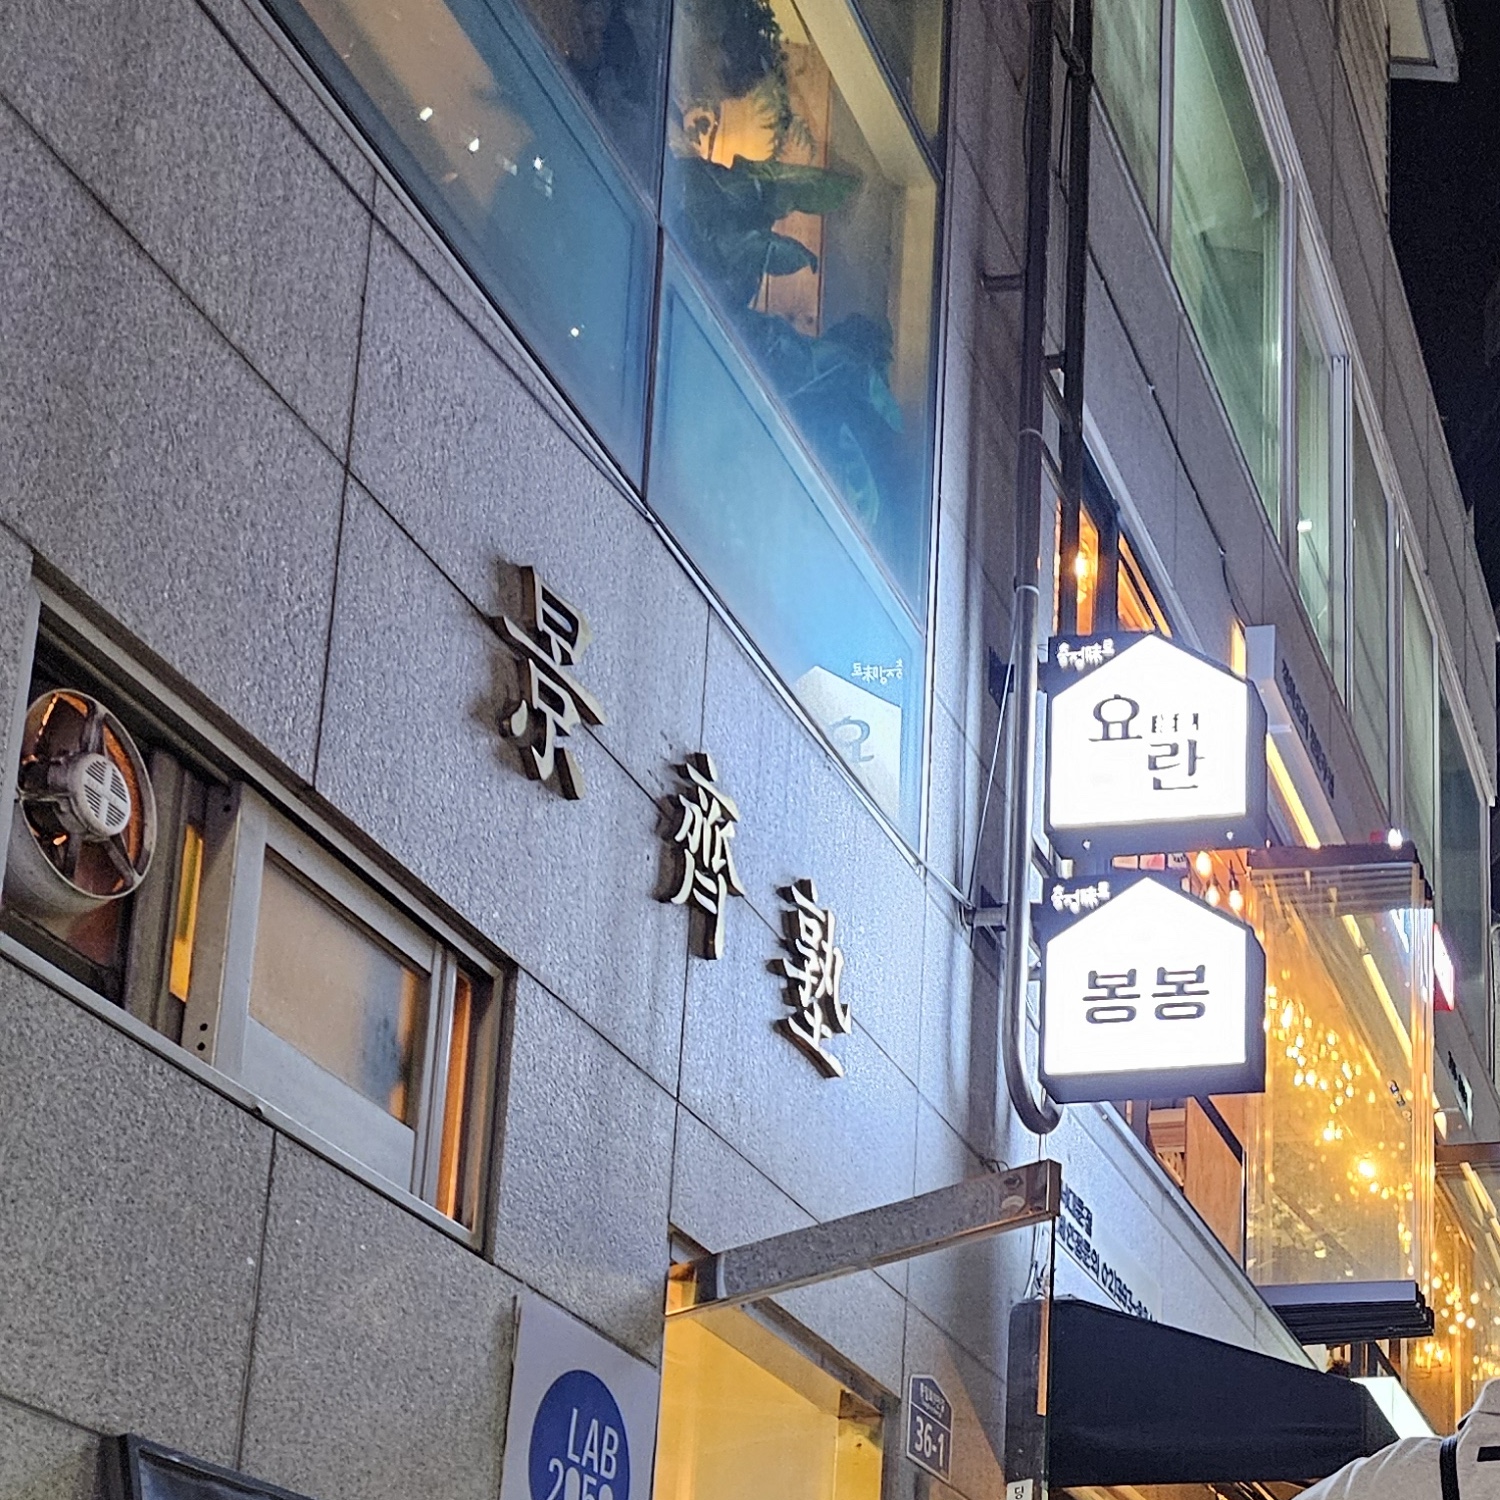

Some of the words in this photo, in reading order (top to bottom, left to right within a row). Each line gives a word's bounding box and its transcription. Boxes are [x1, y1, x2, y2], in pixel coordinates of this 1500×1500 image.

[1083, 964, 1210, 1024] 봉봉
[568, 1407, 619, 1480] LAB
[915, 1416, 944, 1468] 36-1
